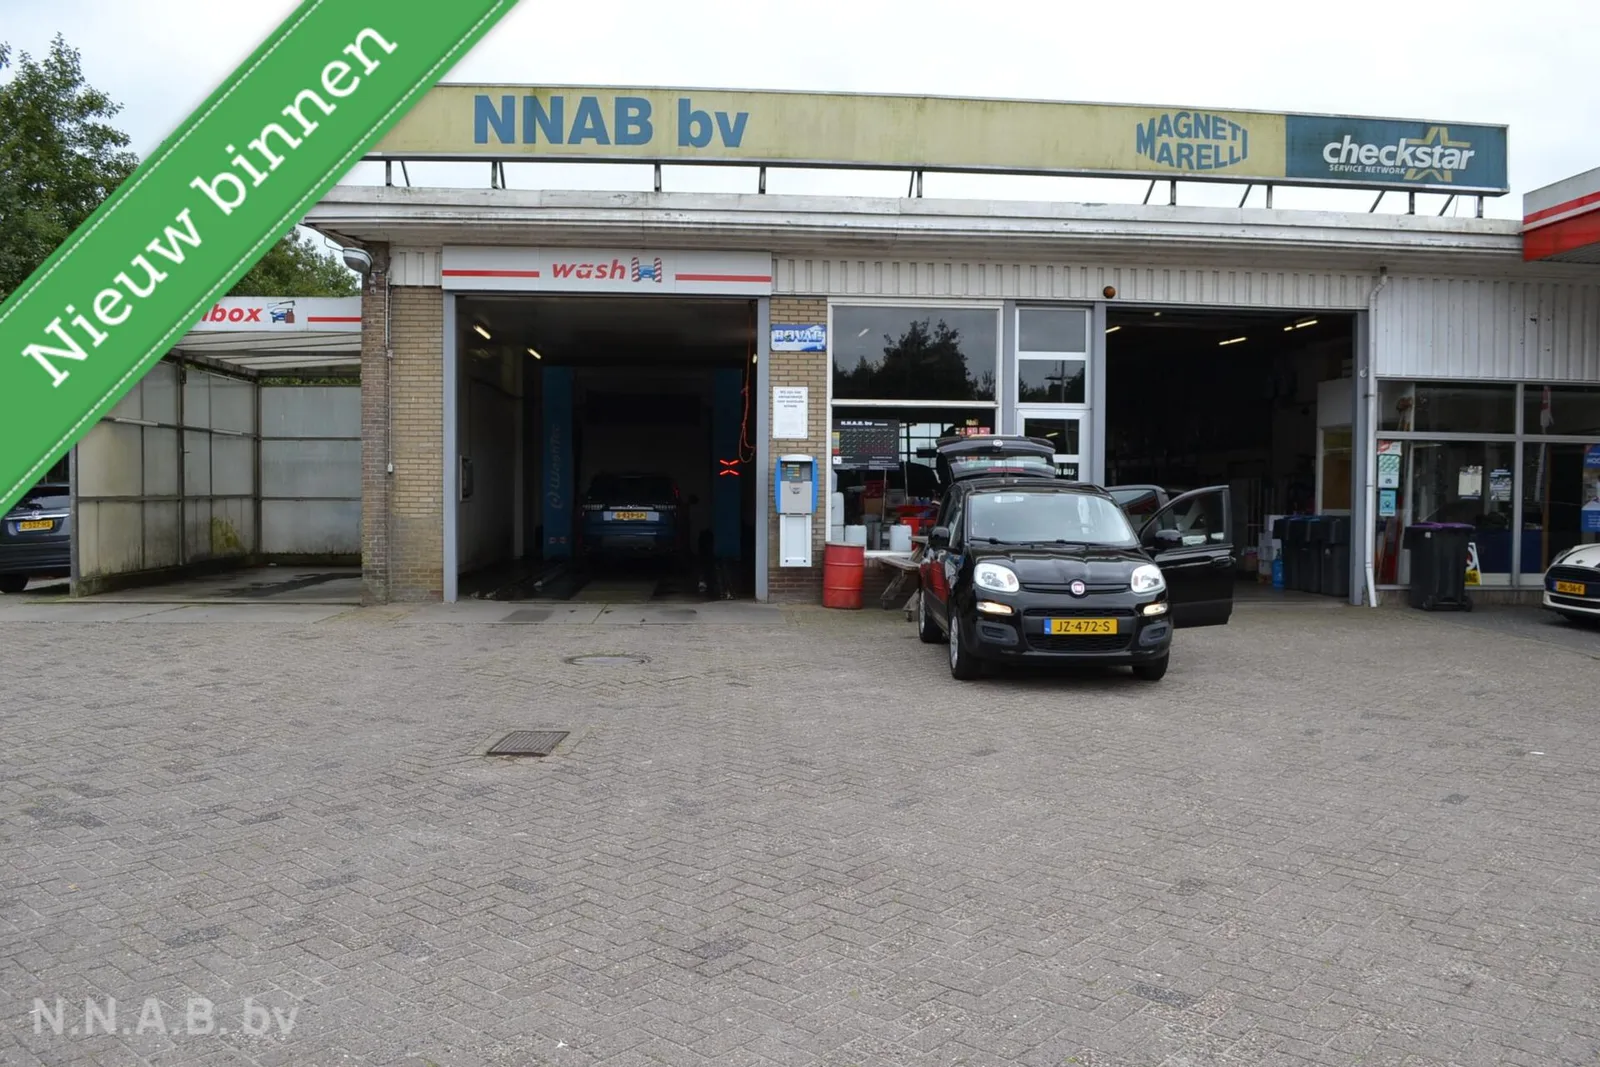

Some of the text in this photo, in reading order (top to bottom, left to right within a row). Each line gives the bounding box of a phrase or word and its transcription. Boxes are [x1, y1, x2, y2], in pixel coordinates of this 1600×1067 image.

[474, 95, 749, 148] NNAB bv
[1136, 111, 1248, 150] MAGNETI
[1136, 132, 1248, 170] MARELLI
[1323, 135, 1475, 170] checkstar
[1329, 164, 1406, 175] SERVICE NETWORK
[552, 259, 626, 280] wash
[201, 303, 263, 323] box
[1056, 620, 1110, 633] JZ-472-S
